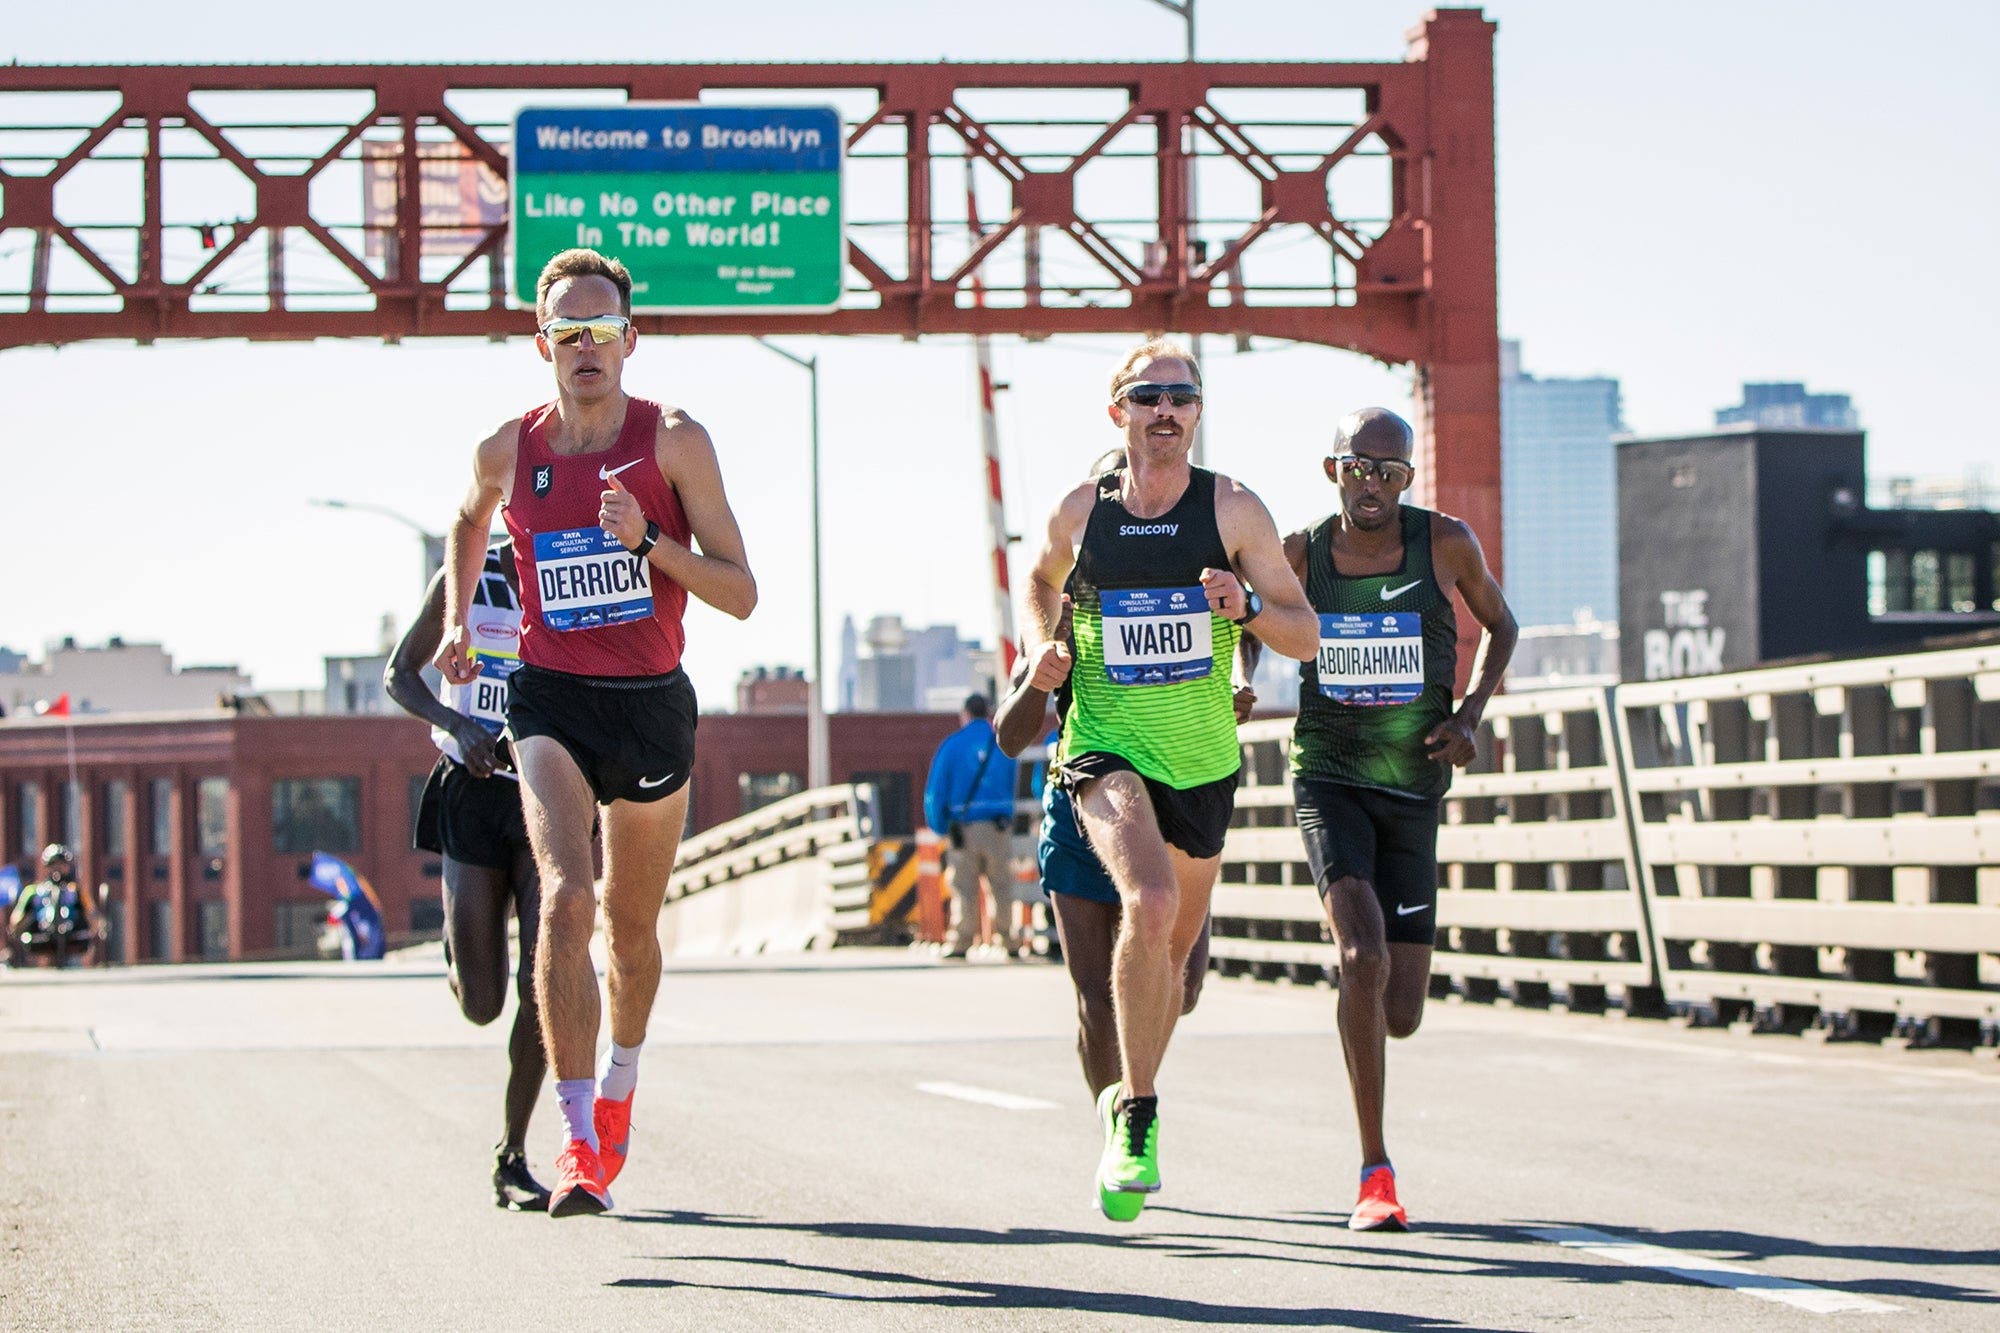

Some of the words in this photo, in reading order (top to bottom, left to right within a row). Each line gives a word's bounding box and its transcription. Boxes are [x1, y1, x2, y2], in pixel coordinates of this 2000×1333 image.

[536, 126, 649, 150] Welcome
[662, 127, 690, 149] to
[701, 124, 821, 151] Brooklyn
[525, 193, 585, 217] Like
[599, 192, 639, 216] No
[652, 192, 737, 217] Other
[751, 192, 831, 216] Place
[577, 223, 602, 247] In
[617, 223, 671, 246] The
[686, 222, 780, 246] World!
[1119, 523, 1179, 536] saucony
[551, 537, 594, 548] CONSULTANCY
[560, 545, 588, 554] SERVICES
[602, 540, 622, 548] TATA
[541, 557, 648, 602] DERRICK
[1119, 599, 1161, 607] CONSULTANCY
[1661, 590, 1708, 628] THE
[1119, 621, 1193, 656] WARD
[1319, 645, 1420, 675] ABDIRAHMAN
[1644, 626, 1726, 680] BOX
